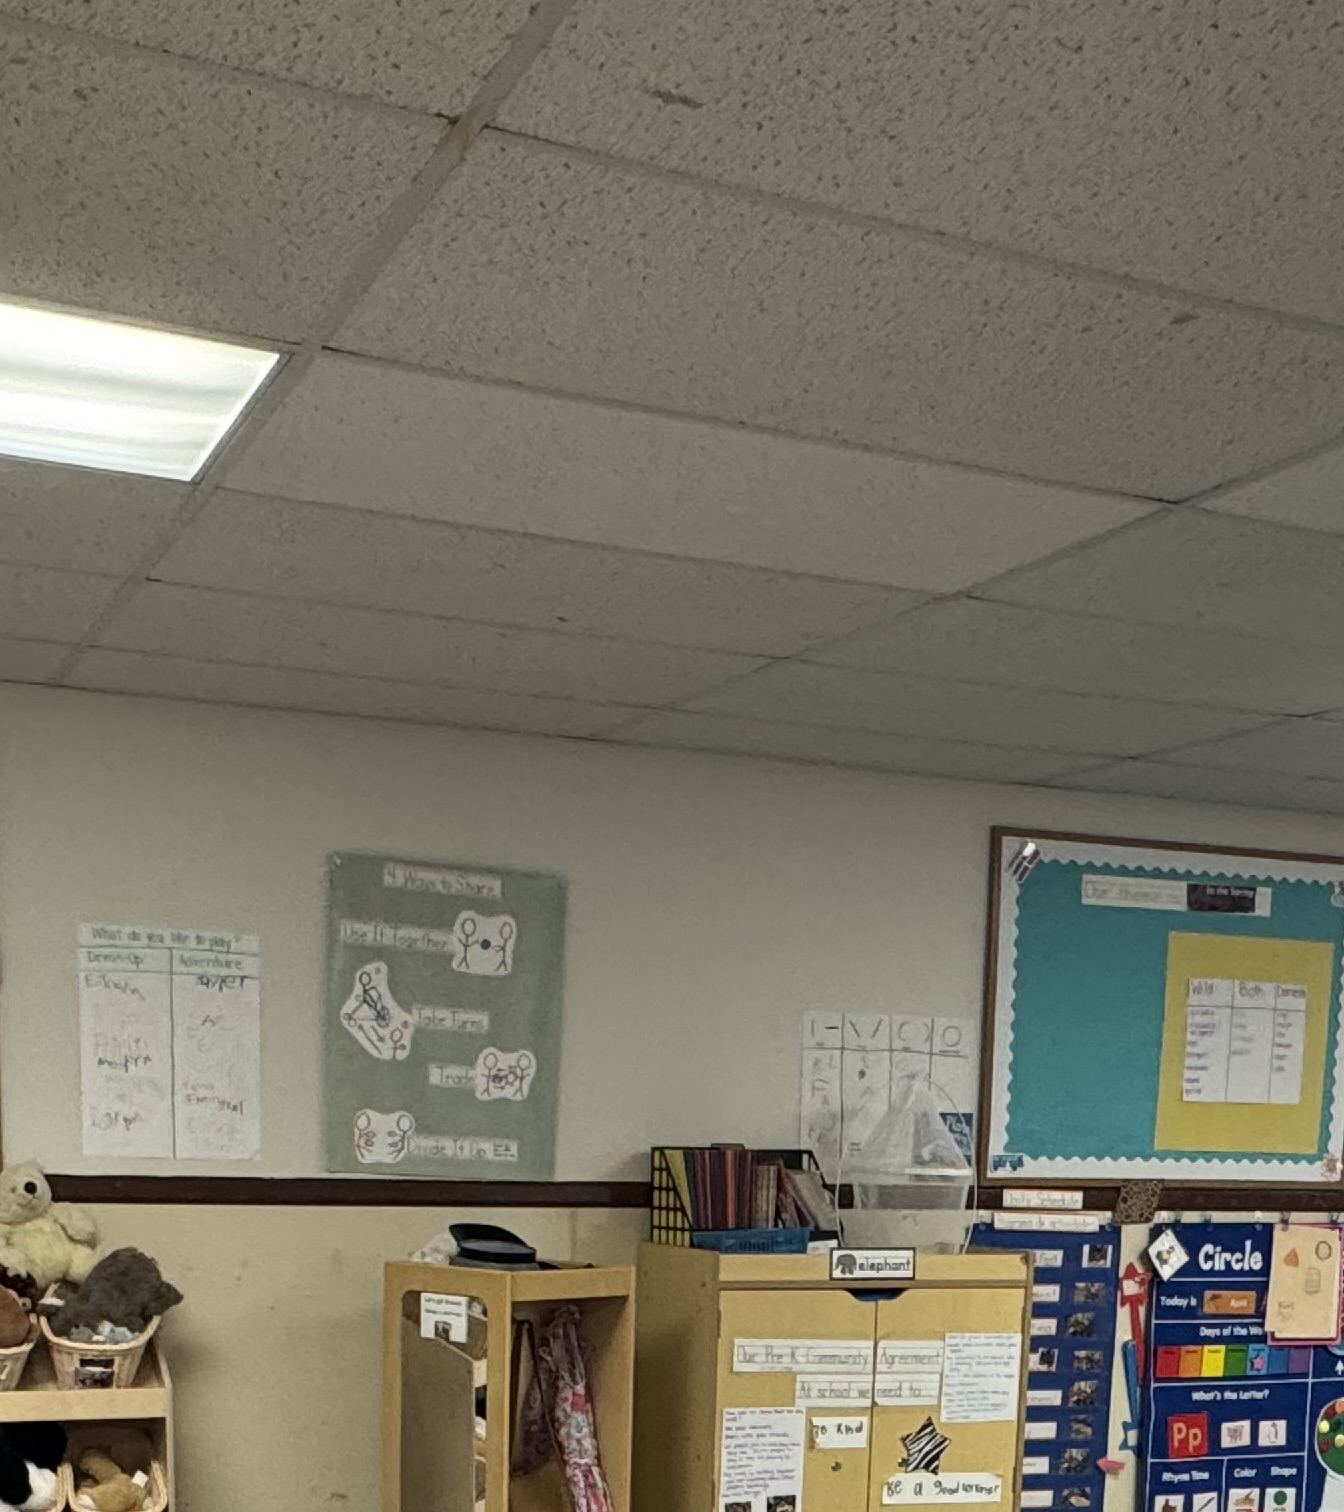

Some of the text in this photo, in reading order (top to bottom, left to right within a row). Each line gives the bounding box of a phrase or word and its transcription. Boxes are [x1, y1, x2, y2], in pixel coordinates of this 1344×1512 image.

[1238, 981, 1266, 999] Both
[1197, 1239, 1264, 1271] Circle
[858, 1256, 911, 1274] elephant
[1159, 1295, 1189, 1310] Today
[1199, 1326, 1221, 1338] Days
[1222, 1325, 1232, 1337] of
[1233, 1325, 1249, 1337] the
[816, 1381, 852, 1398] school
[876, 1381, 903, 1398] need
[1191, 1390, 1222, 1401] What's
[1223, 1390, 1238, 1400] the
[1172, 1421, 1203, 1453] Pp
[1233, 1467, 1257, 1479] Color
